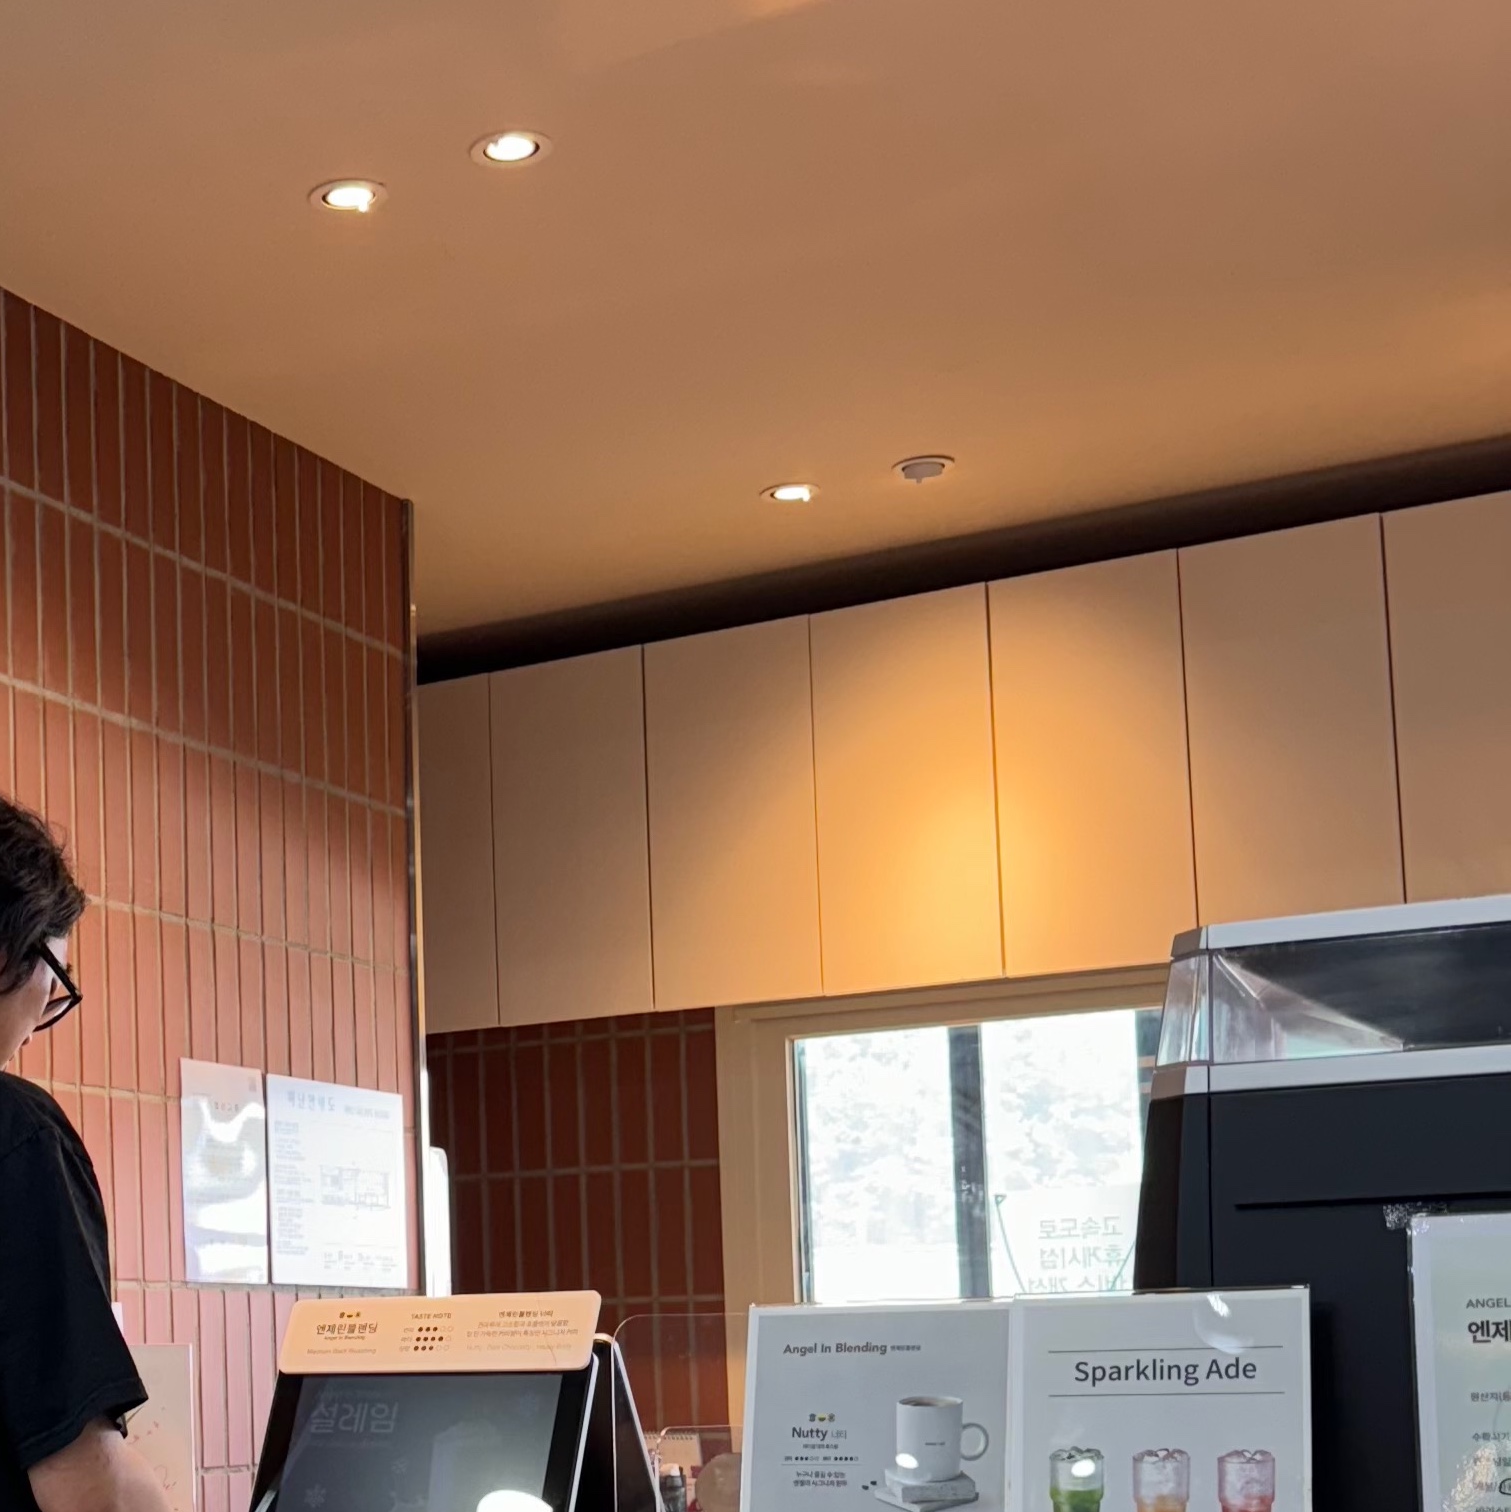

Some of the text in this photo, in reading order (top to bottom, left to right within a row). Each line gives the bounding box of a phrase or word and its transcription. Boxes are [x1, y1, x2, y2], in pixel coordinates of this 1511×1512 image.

[783, 1343, 817, 1357] Angel
[821, 1343, 832, 1354] In
[835, 1341, 887, 1355] Blending
[1074, 1356, 1257, 1387] Sparkling Ade
[310, 1401, 399, 1433] 설레임
[791, 1426, 828, 1442] Nutty
